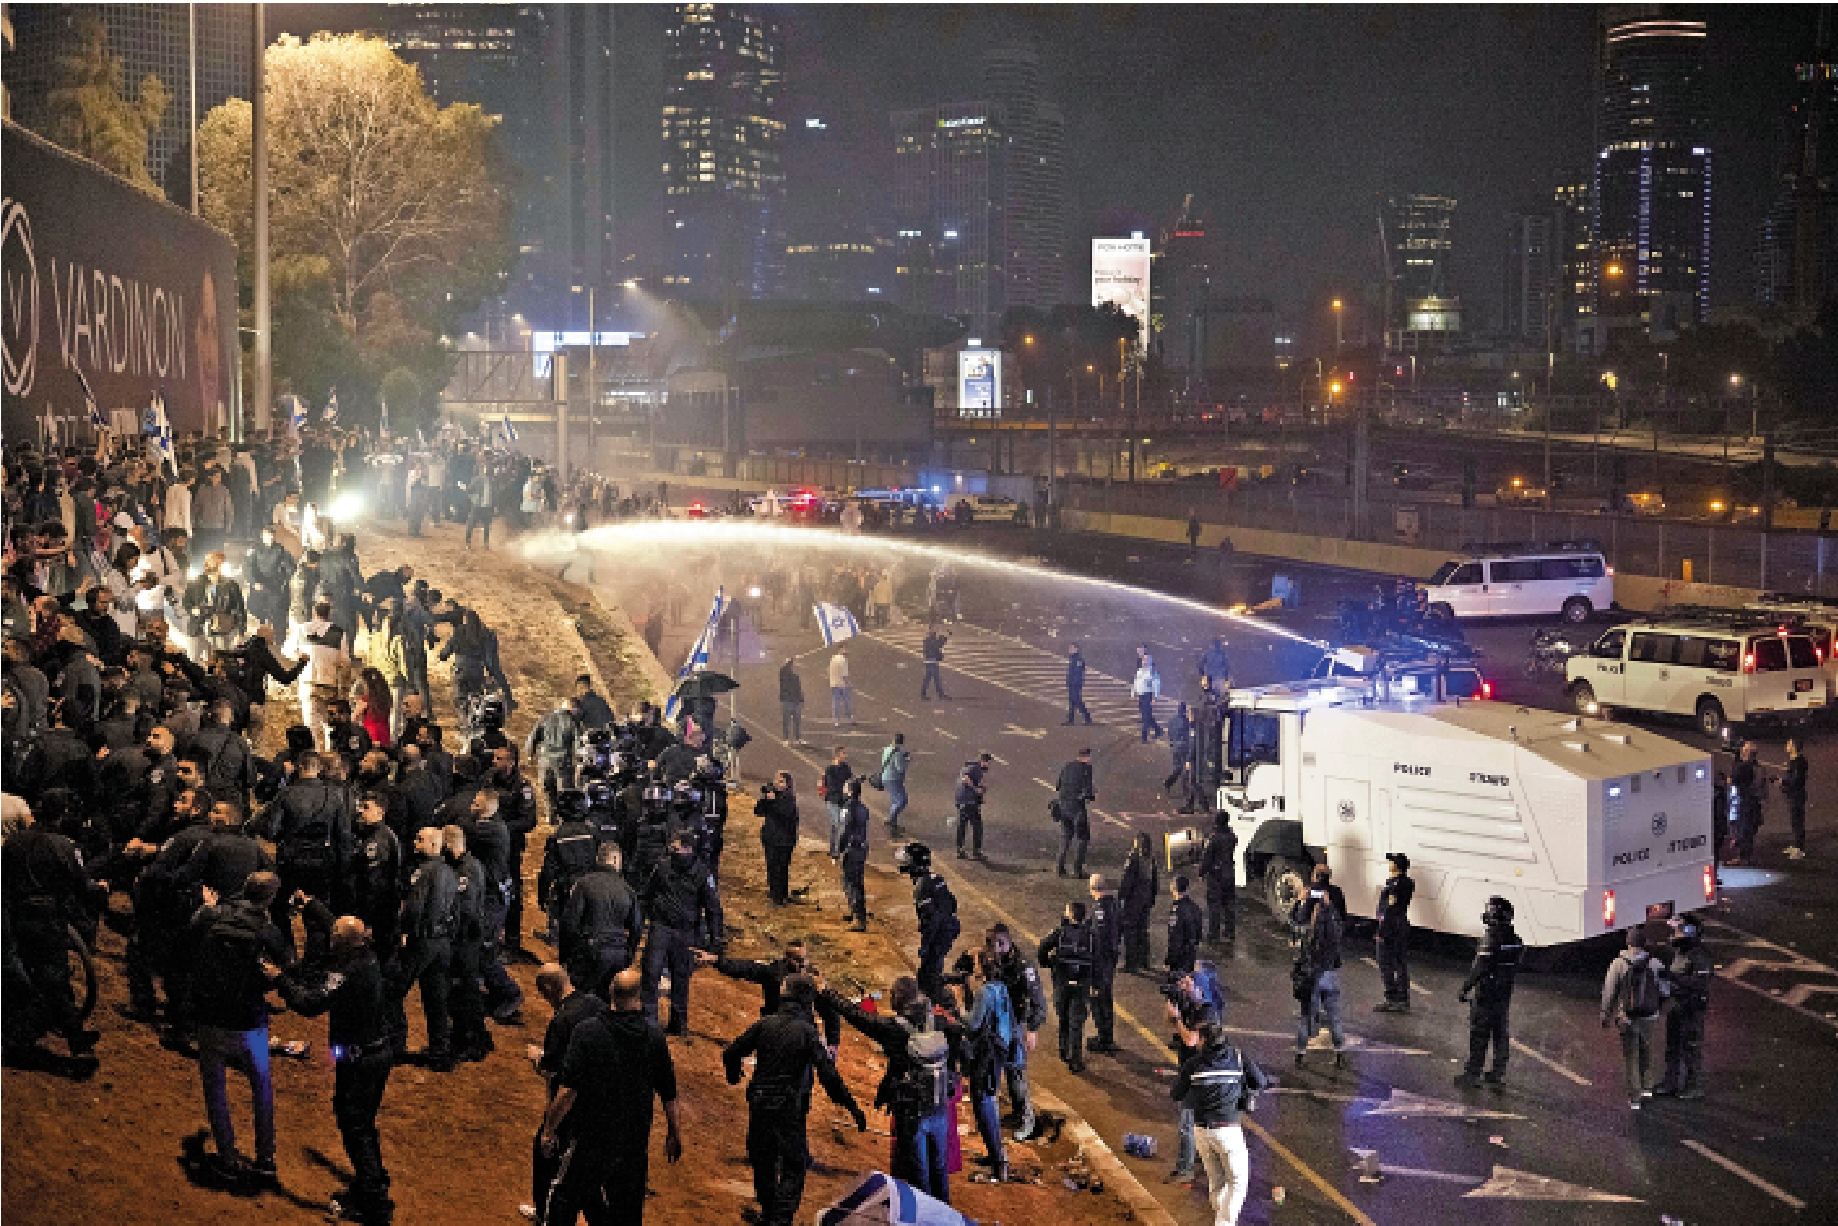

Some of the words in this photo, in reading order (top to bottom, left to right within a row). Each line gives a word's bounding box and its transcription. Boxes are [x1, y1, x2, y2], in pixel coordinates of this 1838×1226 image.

[51, 256, 187, 380] VARDINON
[1393, 760, 1432, 778] POLICE
[1612, 847, 1650, 867] POLICE
